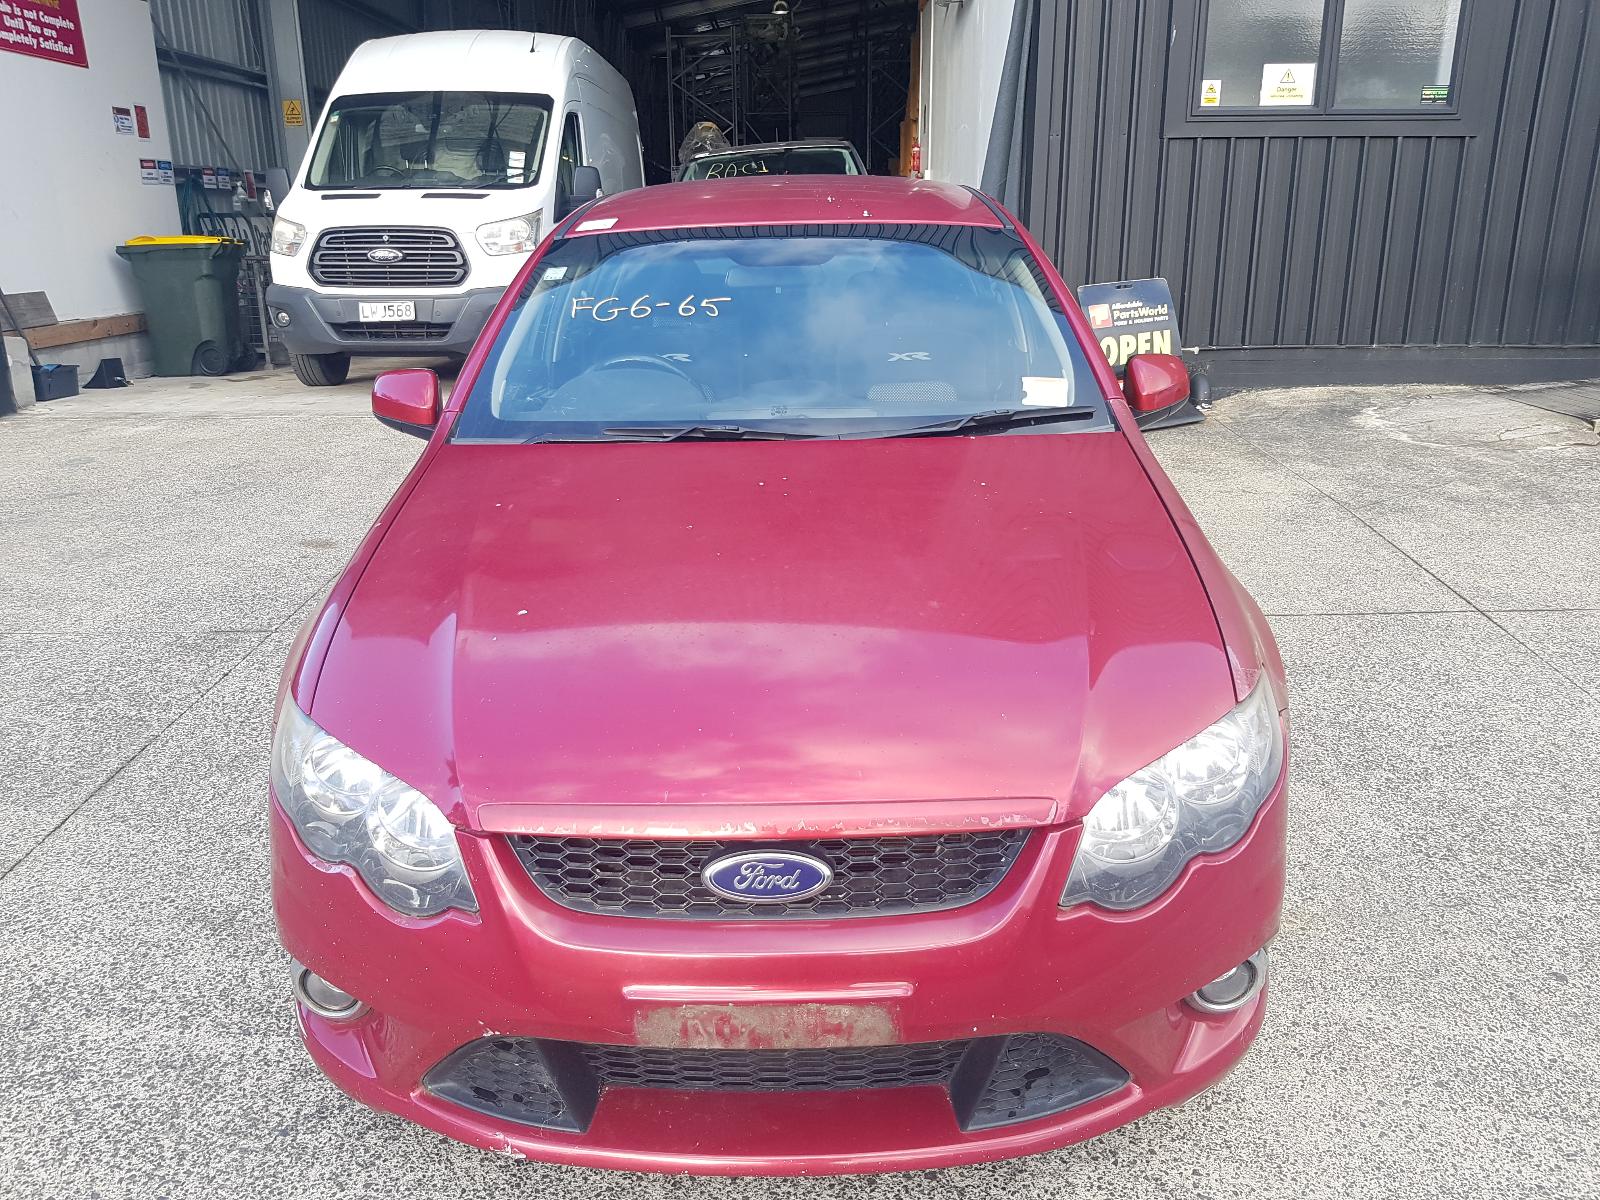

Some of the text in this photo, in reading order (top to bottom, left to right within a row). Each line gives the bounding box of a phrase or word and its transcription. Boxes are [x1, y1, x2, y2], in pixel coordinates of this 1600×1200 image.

[3, 14, 57, 38] Until You are
[13, 3, 22, 15] is
[23, 9, 37, 20] not
[39, 11, 75, 30] Complete
[39, 37, 74, 55] Satisfied
[571, 294, 732, 322] FG6-65
[1113, 303, 1168, 321] PartsWorld
[887, 351, 932, 362] XR
[1100, 329, 1172, 367] OPEN
[733, 861, 802, 890] Ford
